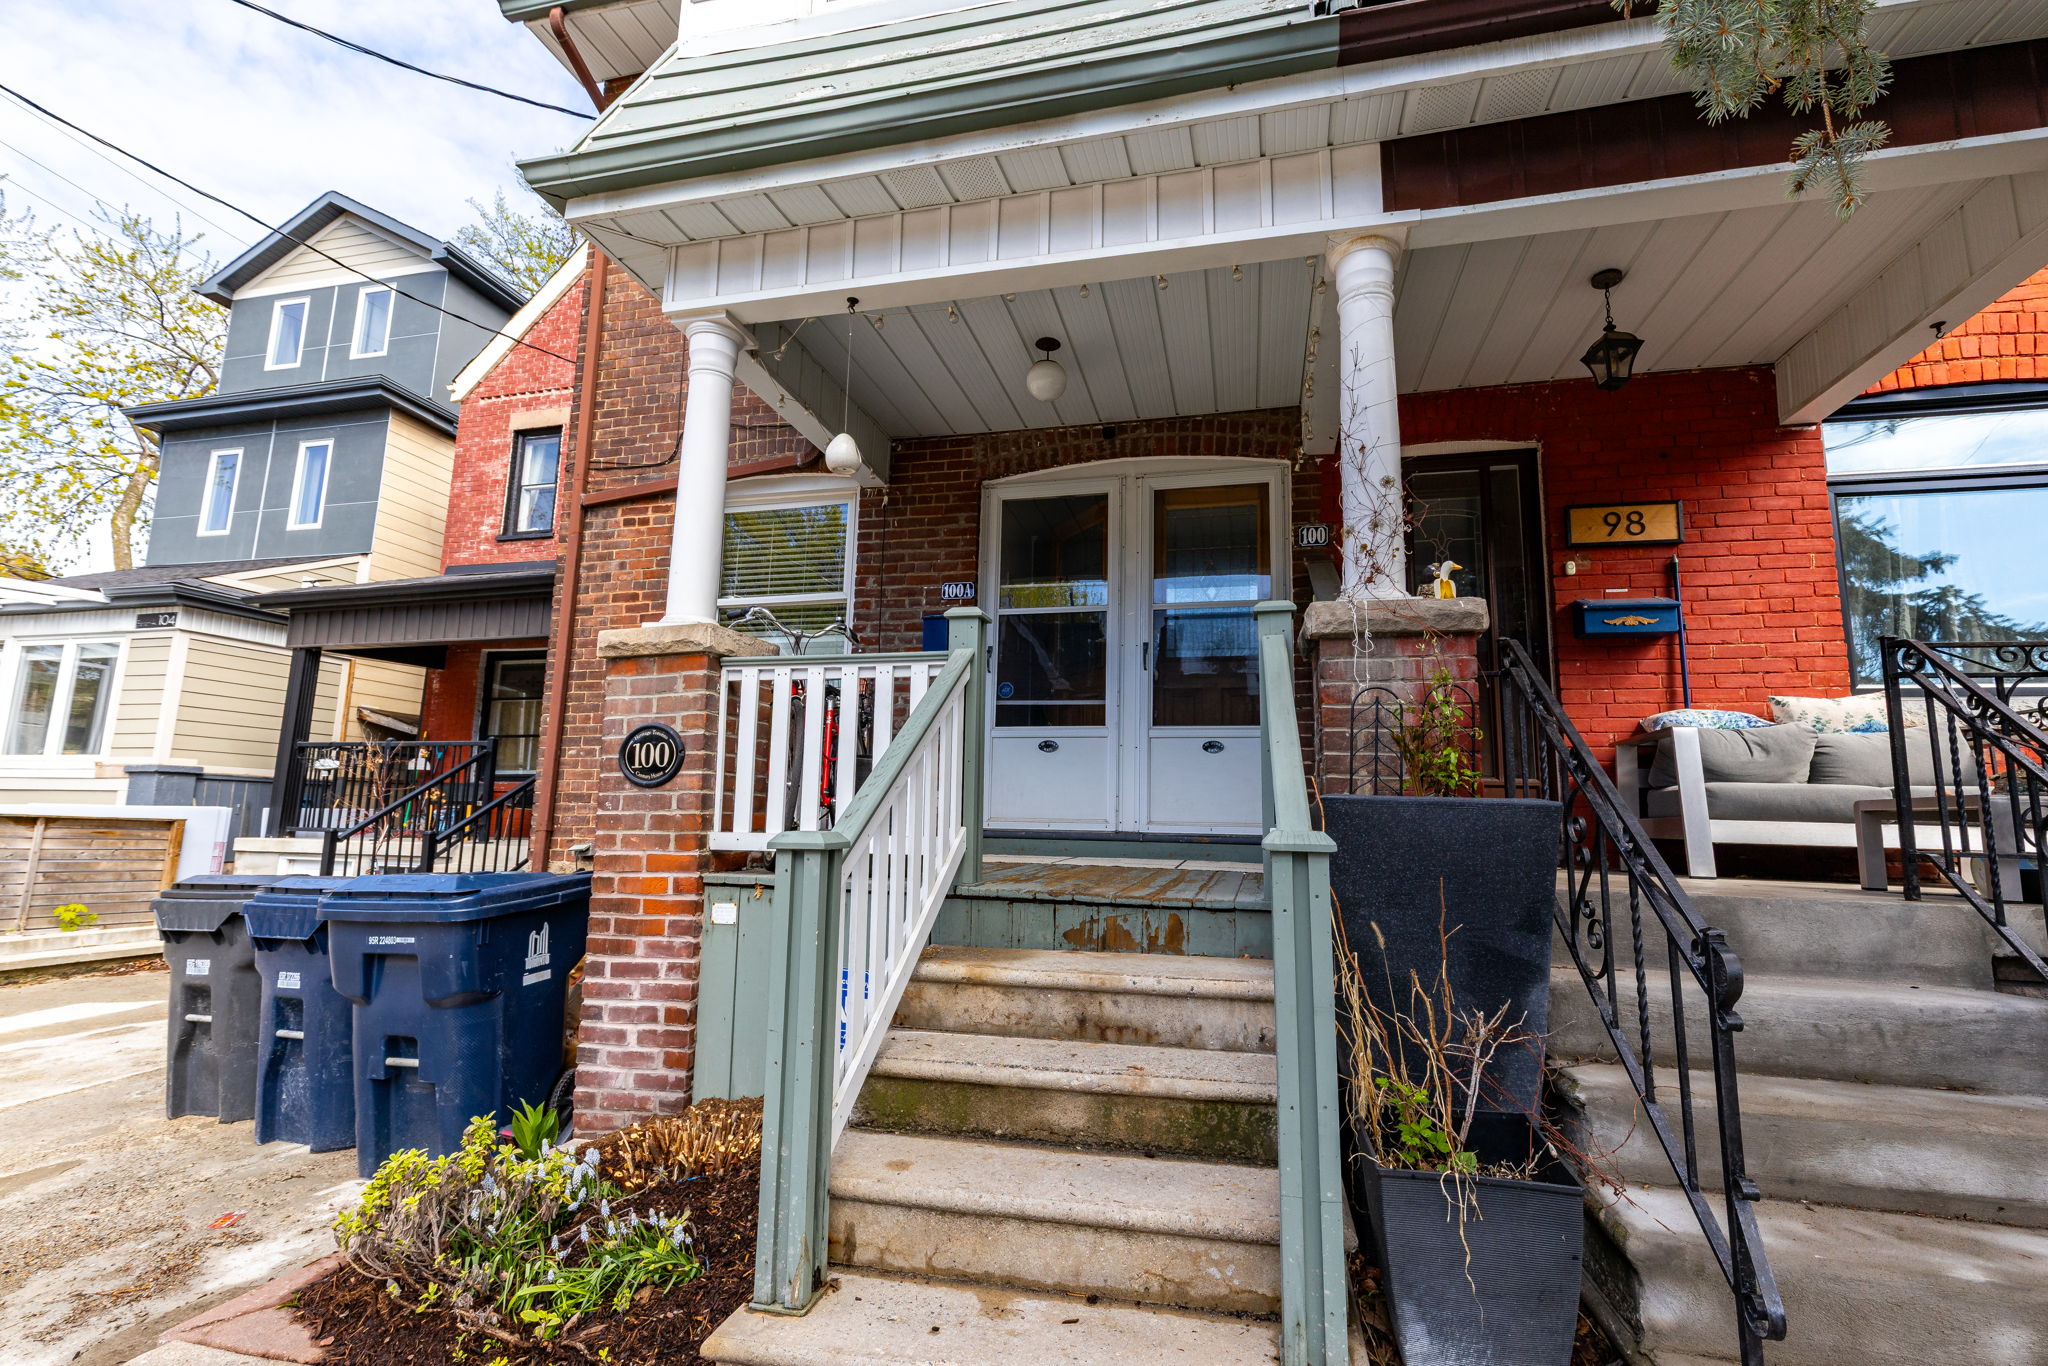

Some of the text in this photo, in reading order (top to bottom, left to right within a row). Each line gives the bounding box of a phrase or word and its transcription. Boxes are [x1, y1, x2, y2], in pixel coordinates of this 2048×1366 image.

[1603, 510, 1646, 537] 98
[1302, 527, 1326, 544] 100
[944, 583, 971, 598] 100A
[158, 614, 175, 626] 104
[631, 741, 670, 769] 100
